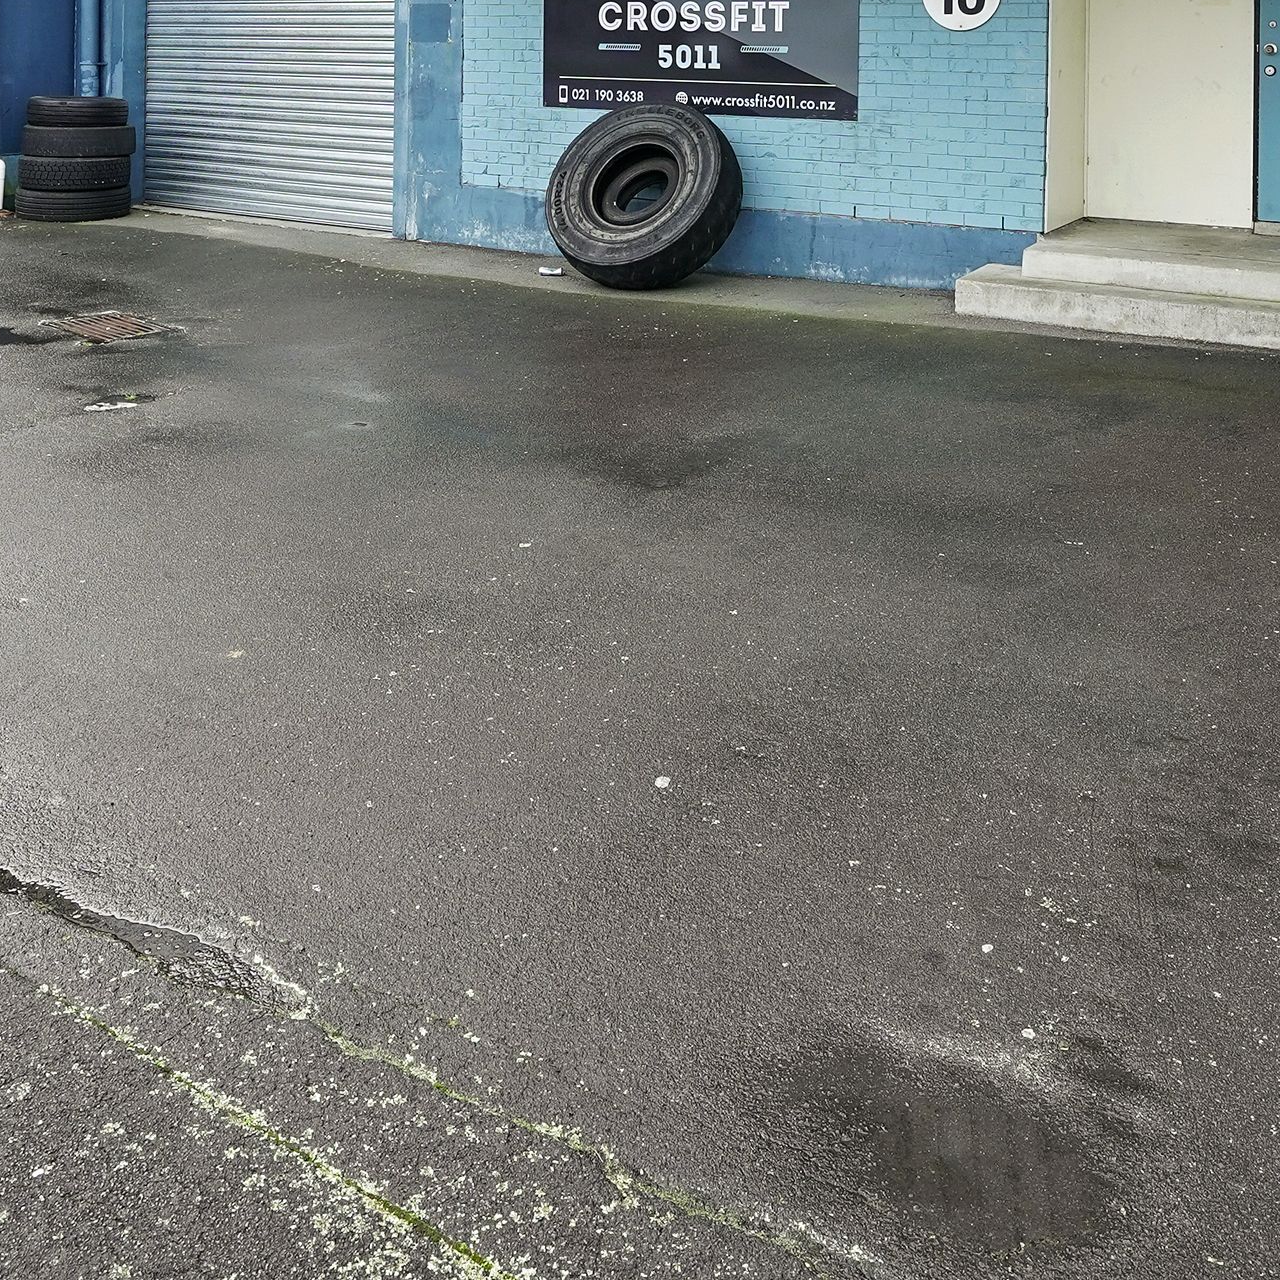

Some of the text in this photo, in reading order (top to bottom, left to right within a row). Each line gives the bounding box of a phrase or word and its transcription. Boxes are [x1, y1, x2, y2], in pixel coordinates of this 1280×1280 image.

[598, 0, 790, 33] CROSSFIT
[658, 45, 721, 70] 5011
[572, 88, 644, 103] 021 190 3638
[691, 94, 836, 112] www.crossfit5011.co.nz
